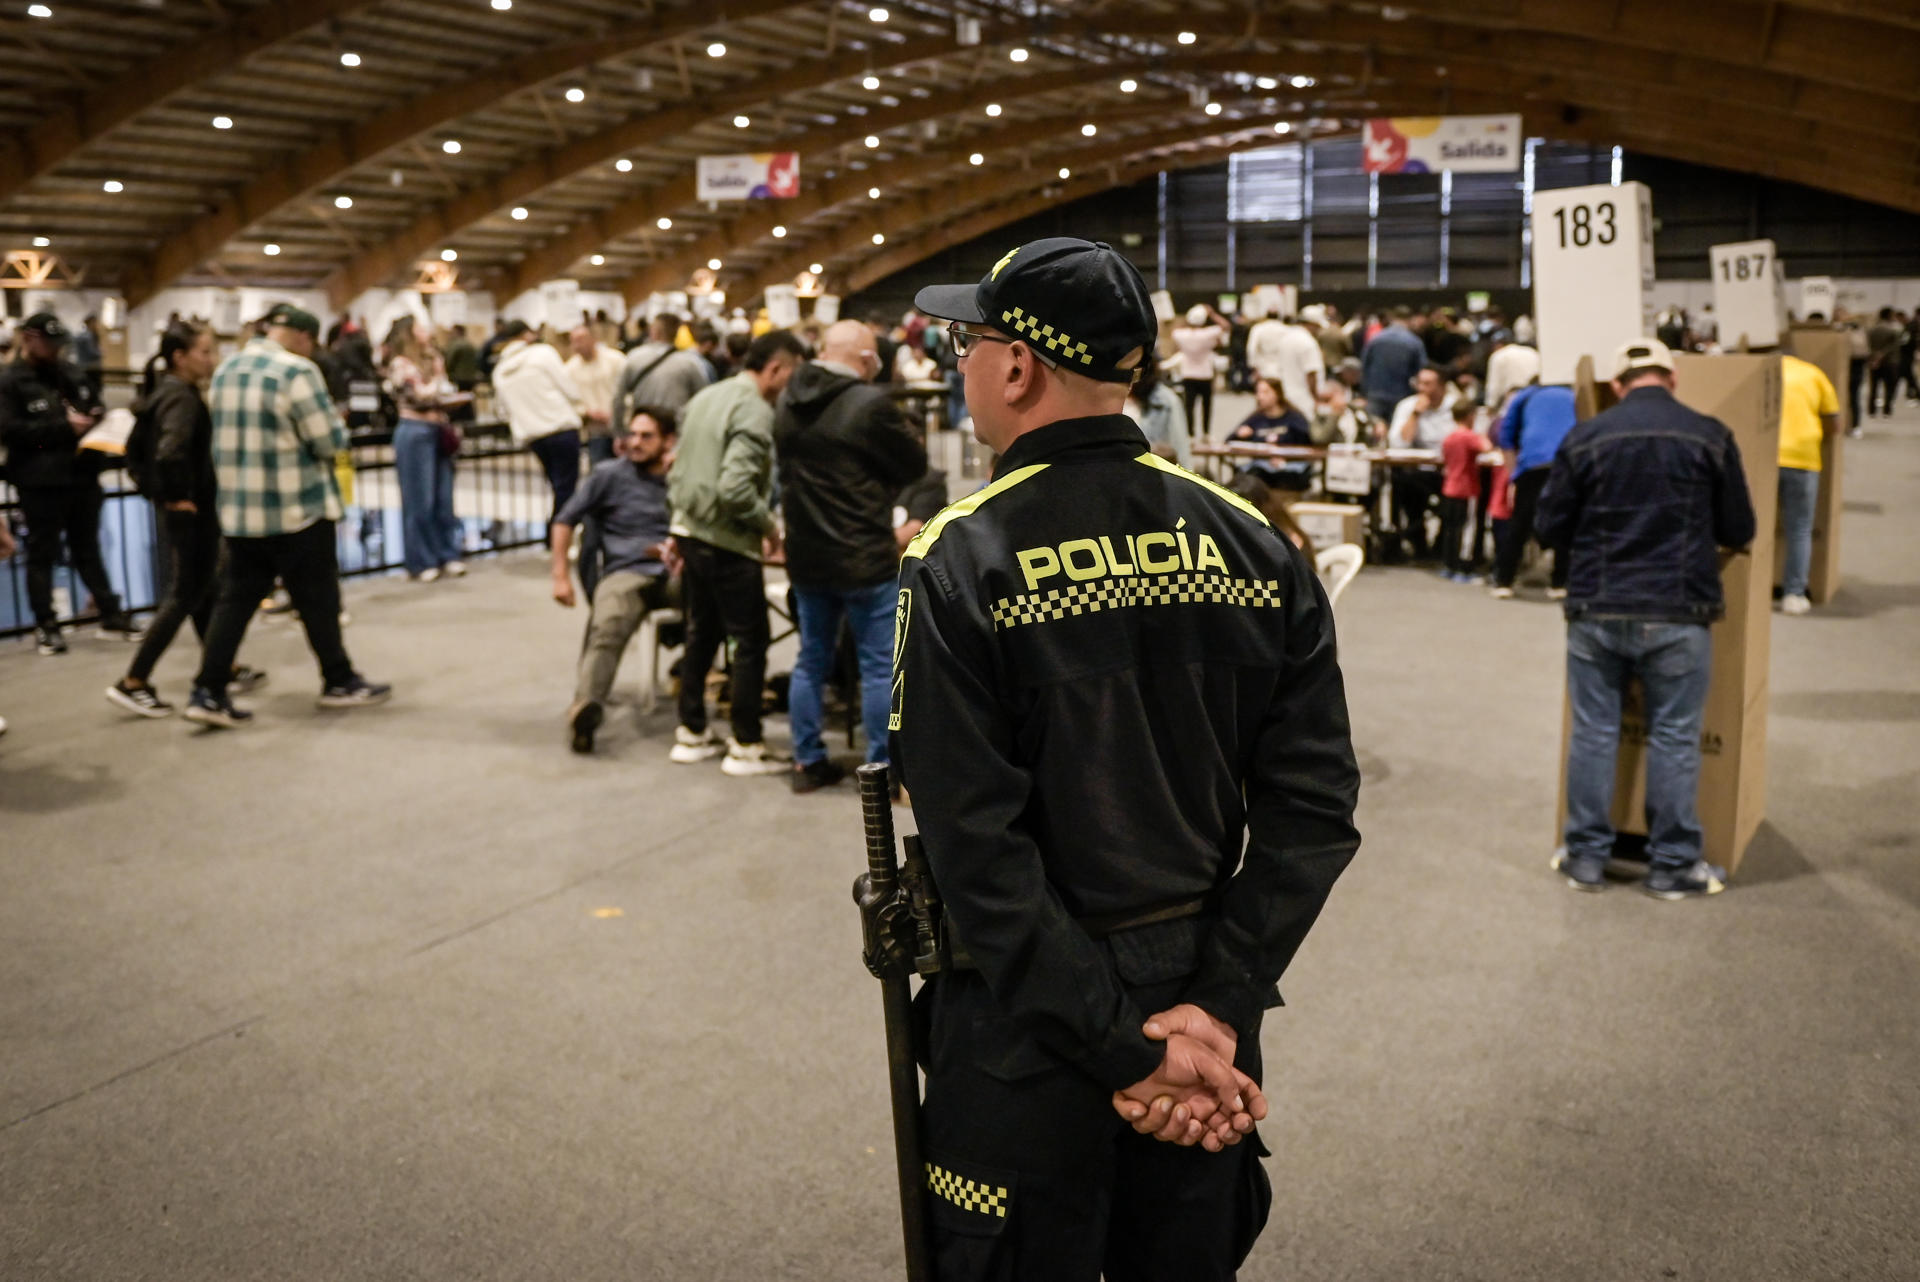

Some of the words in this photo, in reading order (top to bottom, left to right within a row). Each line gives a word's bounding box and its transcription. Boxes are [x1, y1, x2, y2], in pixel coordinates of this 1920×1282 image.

[1441, 139, 1507, 159] Salida
[1553, 202, 1616, 248] 183
[1719, 254, 1767, 281] 187
[1015, 516, 1230, 591] POLICÍA
